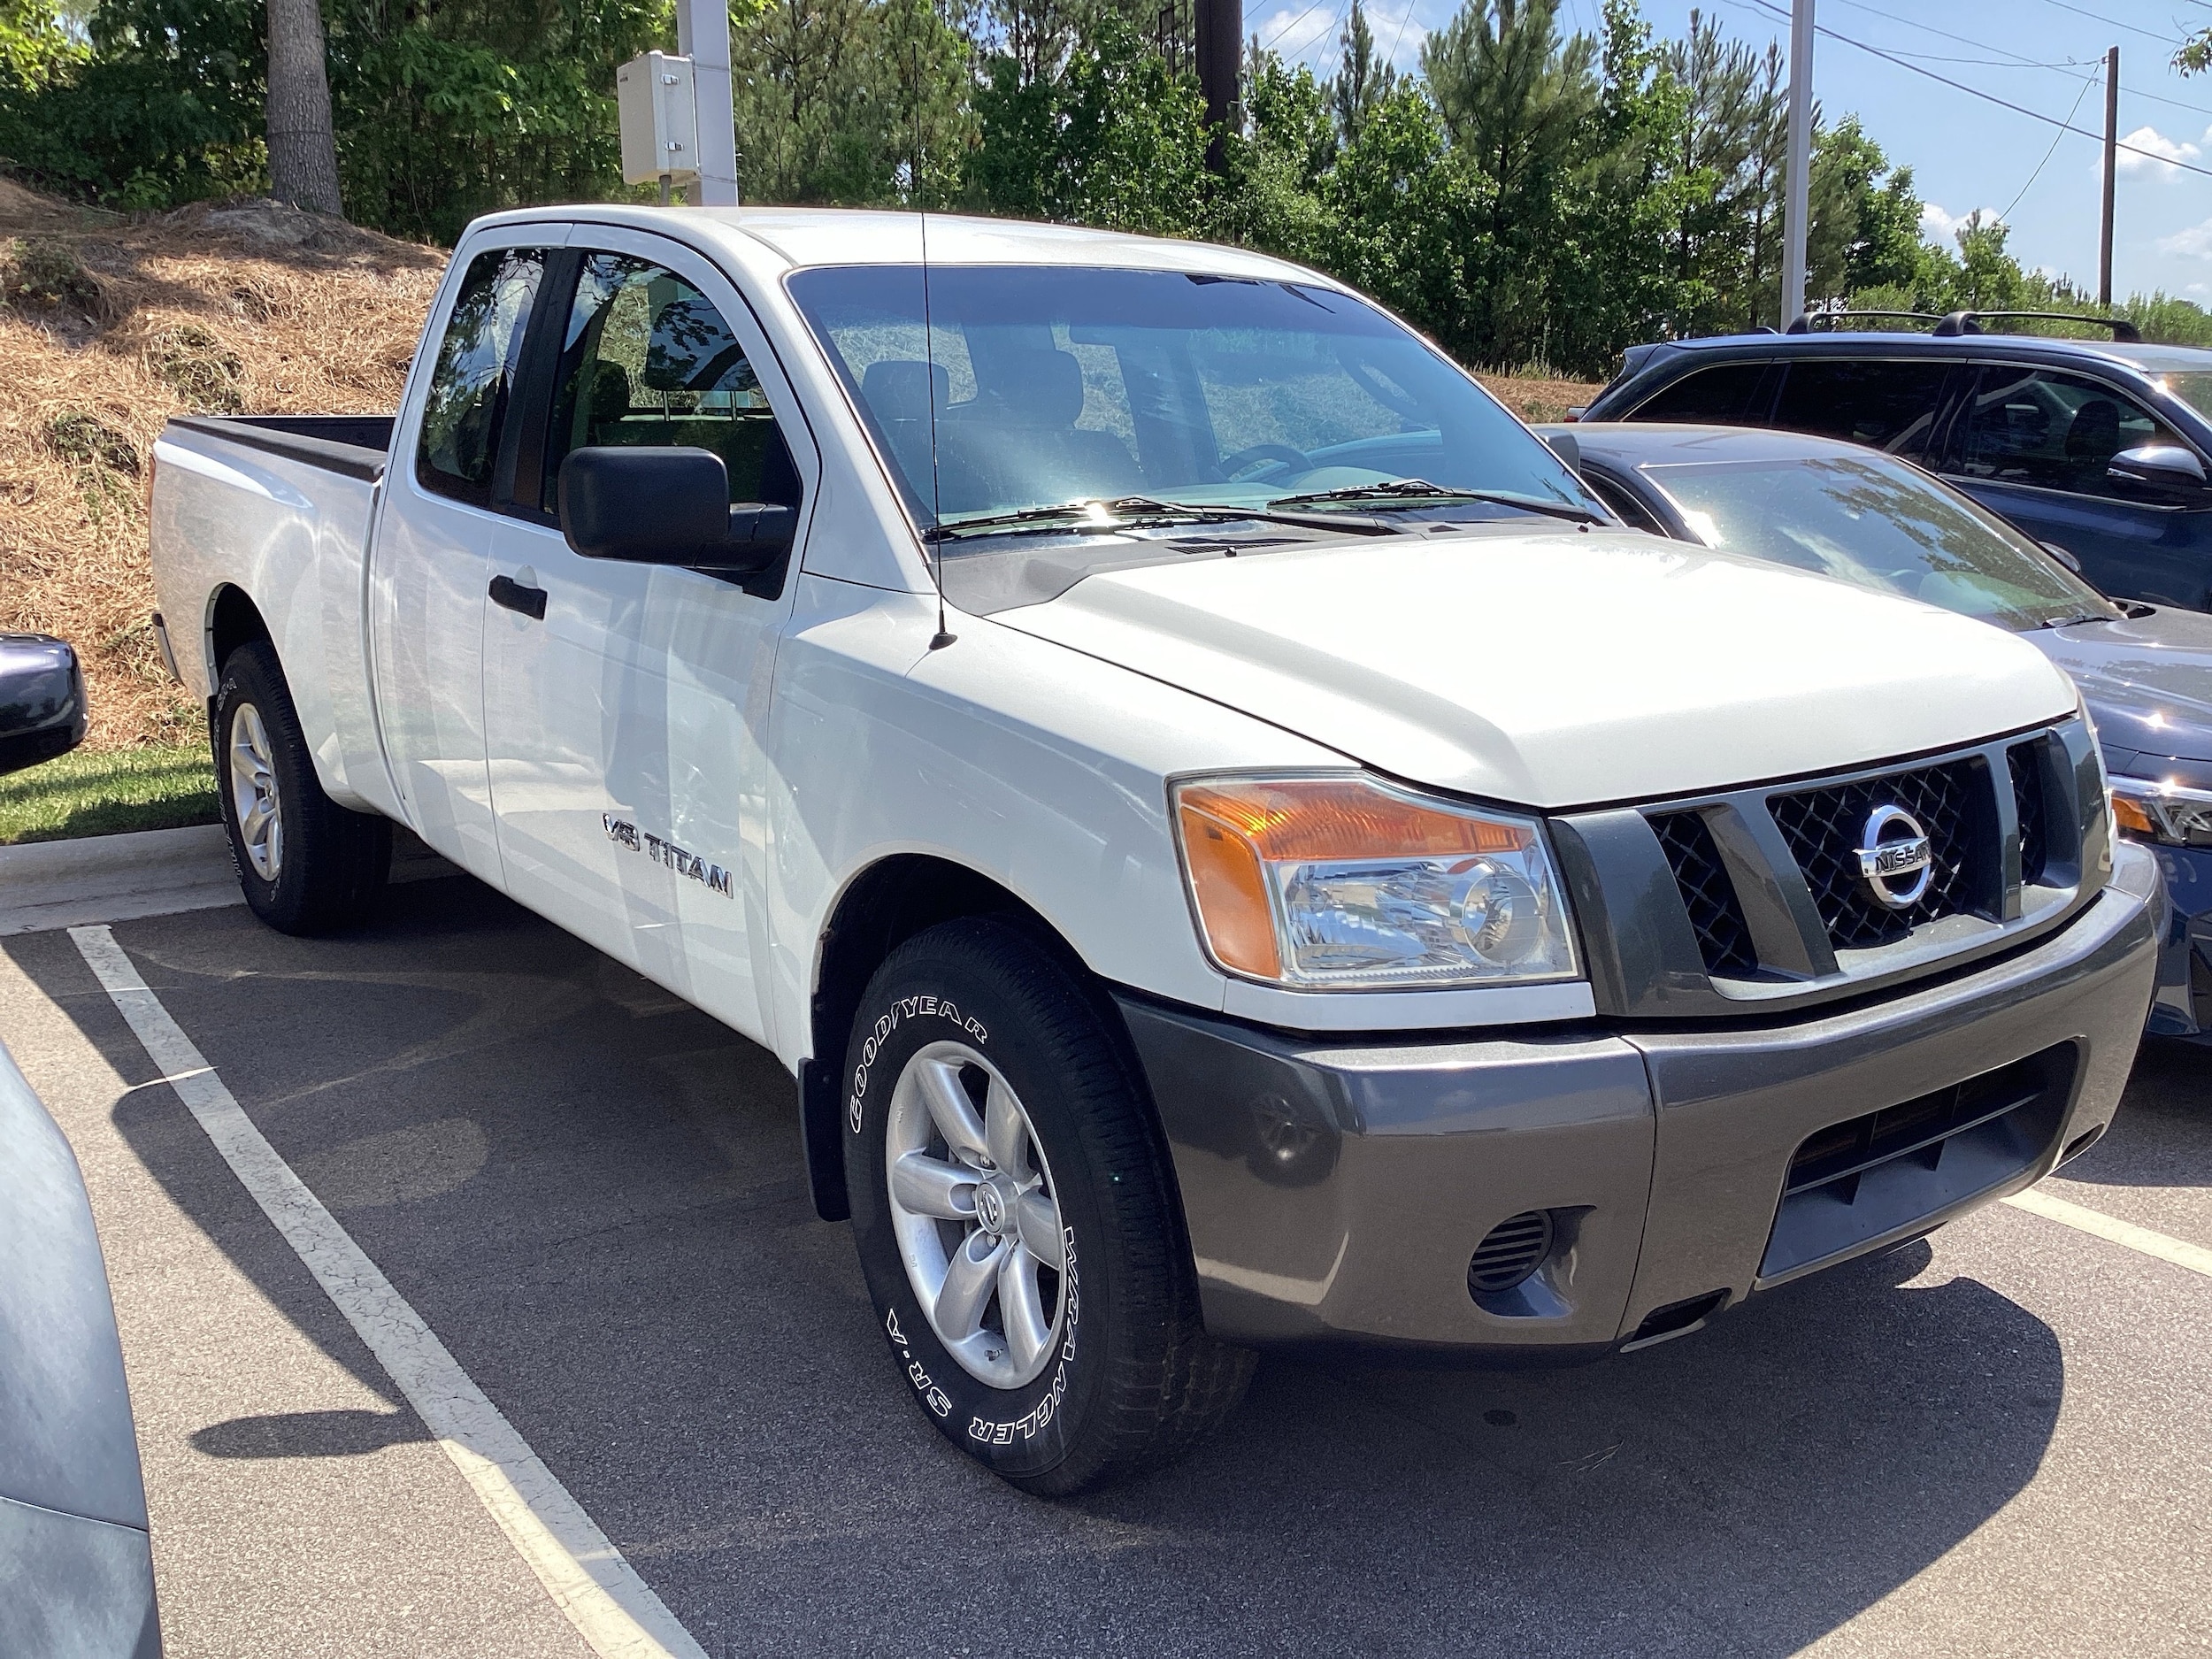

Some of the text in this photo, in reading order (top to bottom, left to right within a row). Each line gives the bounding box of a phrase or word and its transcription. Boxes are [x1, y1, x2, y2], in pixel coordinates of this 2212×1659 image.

[603, 812, 733, 899] V8 TITAN
[1874, 843, 1930, 873] NISSAN
[850, 995, 988, 1133] GOODYEAR
[968, 1225, 1079, 1444] WRANGLER
